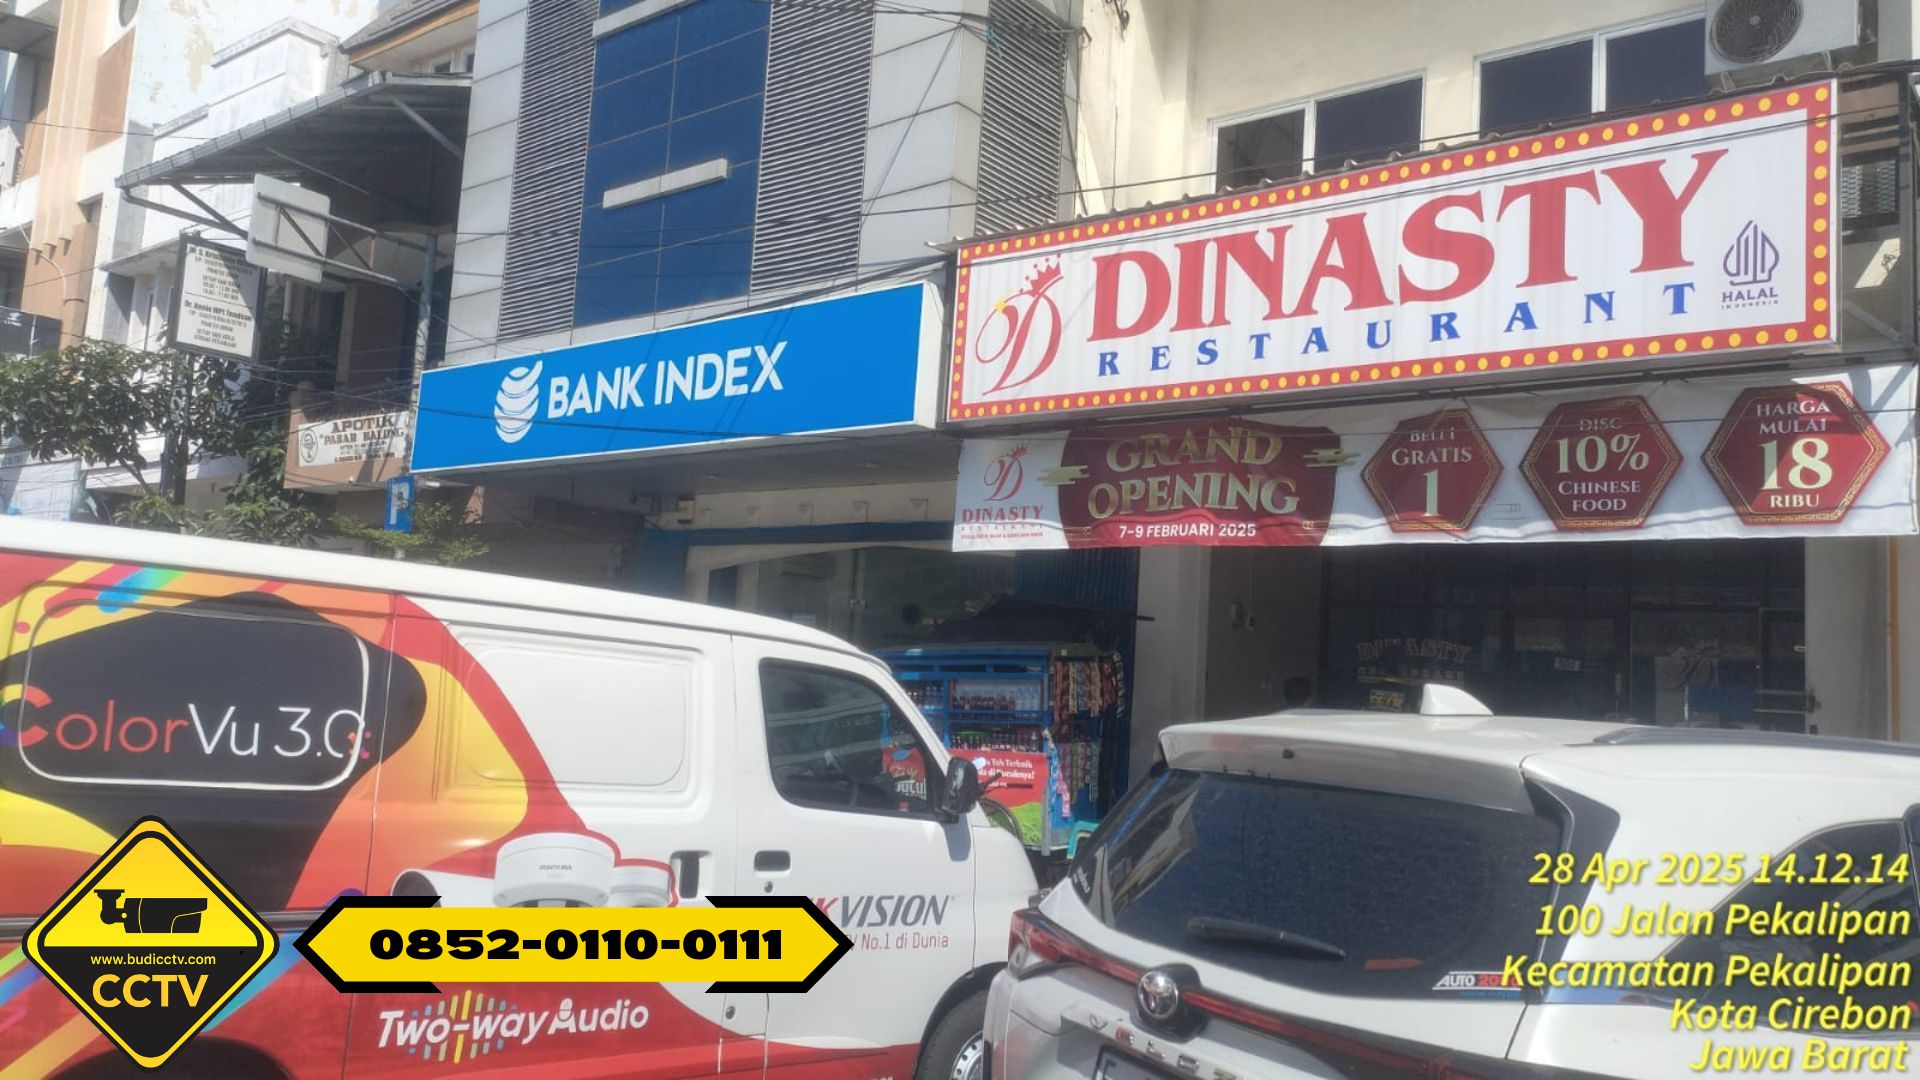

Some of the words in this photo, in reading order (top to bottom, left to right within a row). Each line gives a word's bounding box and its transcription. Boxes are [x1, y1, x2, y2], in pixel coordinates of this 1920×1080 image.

[1087, 148, 1728, 342] DINASTY
[1722, 287, 1779, 303] HALAL
[1097, 281, 1695, 377] RESTAURANT
[547, 363, 647, 419] BANK
[654, 341, 788, 405] INDEX
[1757, 400, 1831, 417] HARGA
[330, 416, 396, 434] APOTIK
[1579, 417, 1622, 432] DISC
[1759, 418, 1827, 435] MULAI
[1106, 427, 1283, 472] GRAND
[1391, 448, 1472, 466] GRATIS
[1556, 433, 1649, 474] 10%
[1758, 437, 1833, 490] 18
[1087, 471, 1300, 519] OPENING
[1422, 469, 1440, 517] 1
[1558, 480, 1641, 496] CHINESE
[1572, 498, 1626, 513] FOOD
[1770, 494, 1820, 508] RIBU
[962, 505, 1044, 523] DINASTY
[1119, 525, 1143, 538] 7-9
[1146, 525, 1213, 538] FEBRUARI
[1218, 524, 1256, 537] 2025
[0, 683, 260, 755] ColorVu
[274, 706, 365, 757] 3.0
[861, 933, 891, 950] No.1
[895, 933, 908, 949] di
[912, 932, 949, 949] Dunia
[1436, 974, 1476, 988] AUTO
[378, 1010, 549, 1048] Two-way
[547, 997, 649, 1035] Audio
